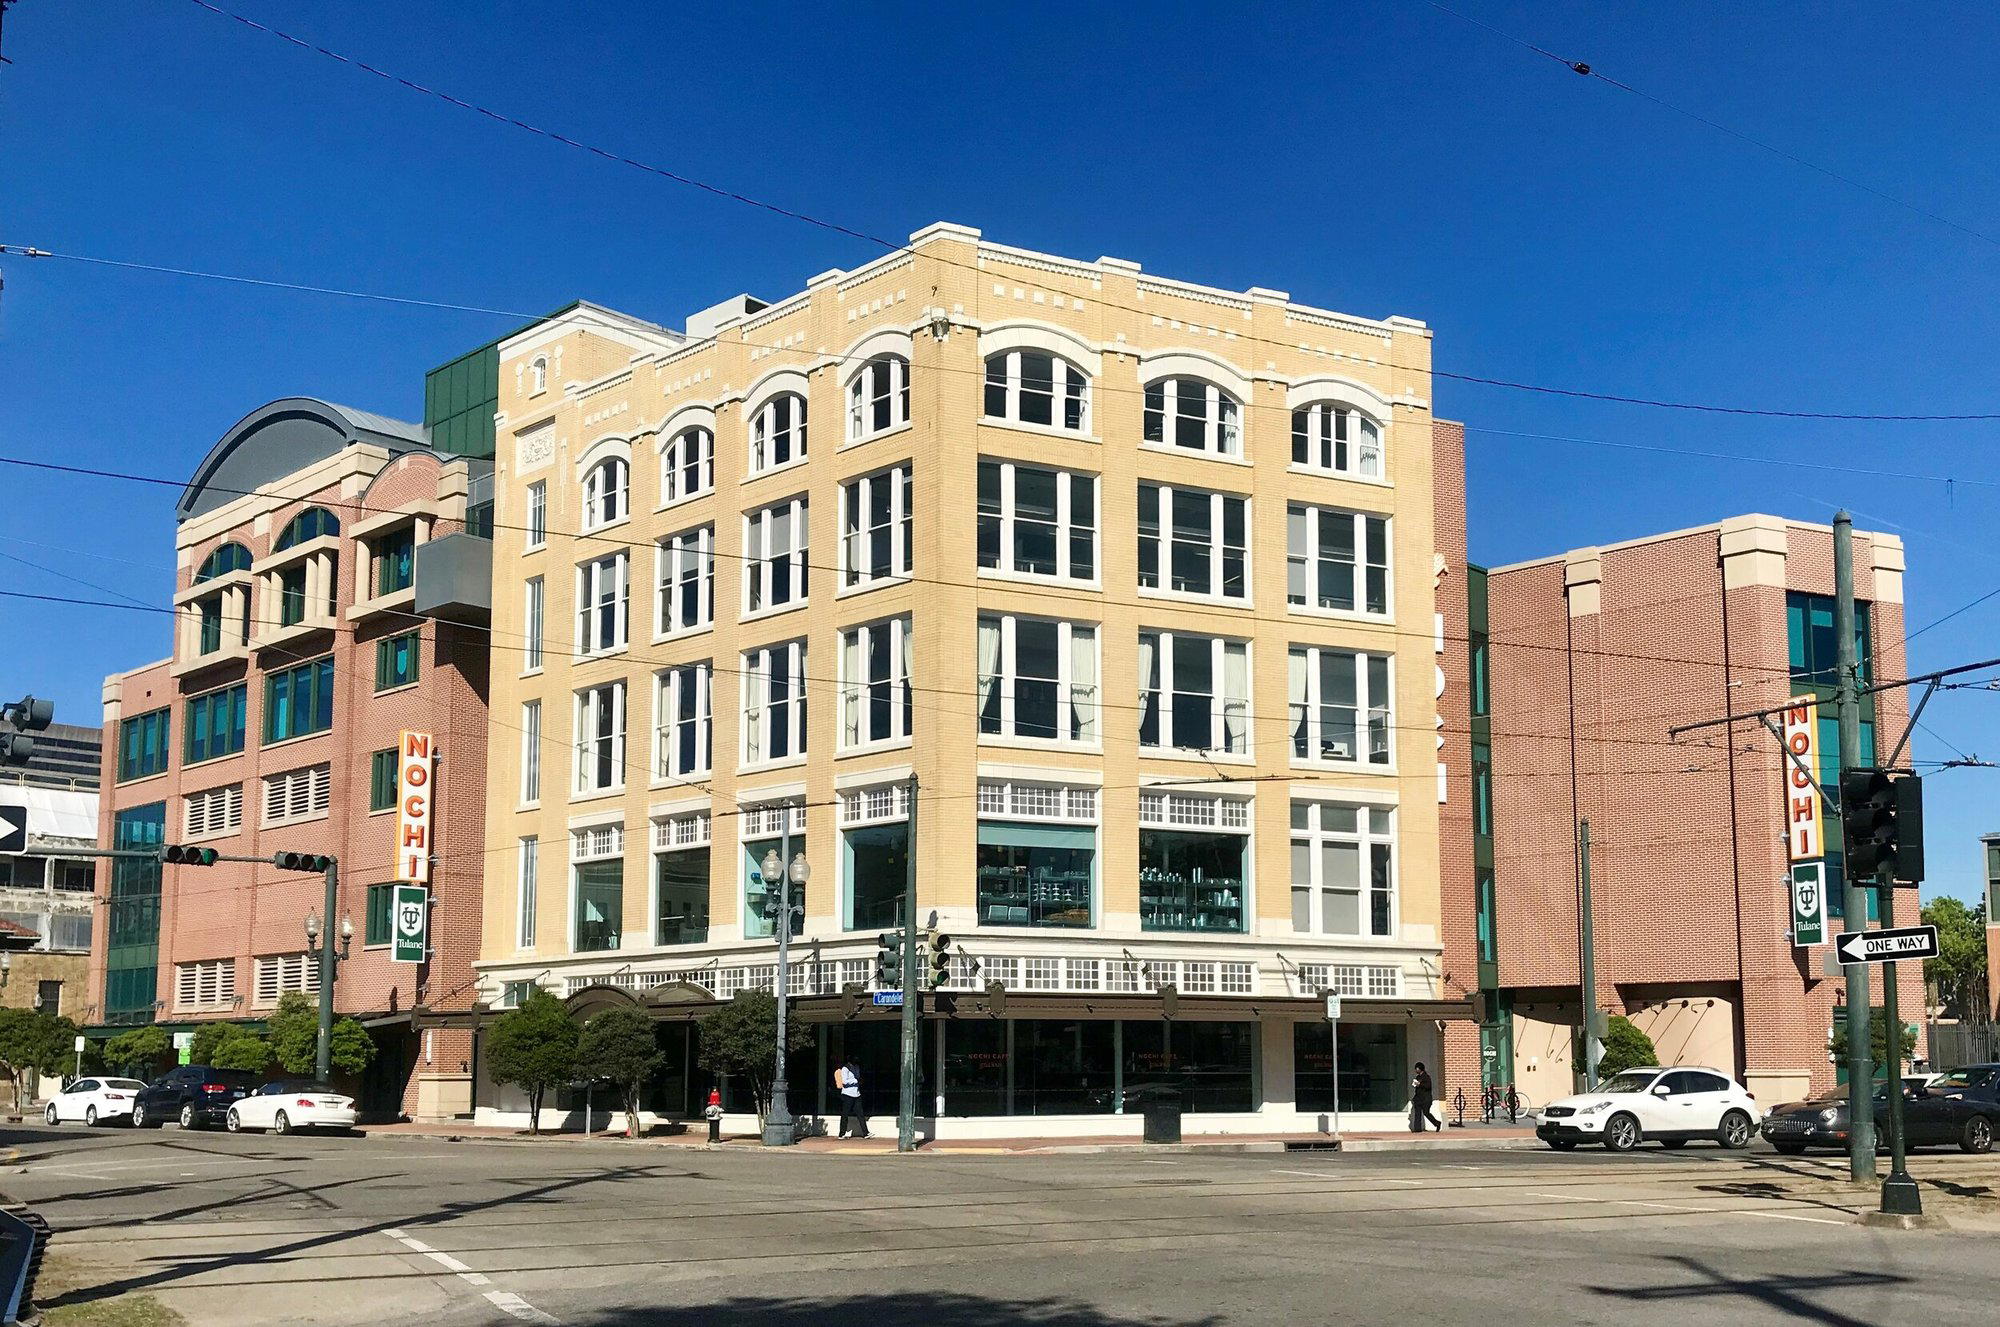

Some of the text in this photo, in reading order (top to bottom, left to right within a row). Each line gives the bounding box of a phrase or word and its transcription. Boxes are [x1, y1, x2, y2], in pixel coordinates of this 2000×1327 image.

[1788, 699, 1813, 854] NOCHI
[403, 734, 429, 877] NOCHI
[1796, 921, 1820, 931] Tulane
[397, 939, 423, 949] Tulane
[1866, 936, 1925, 952] ONE WAY
